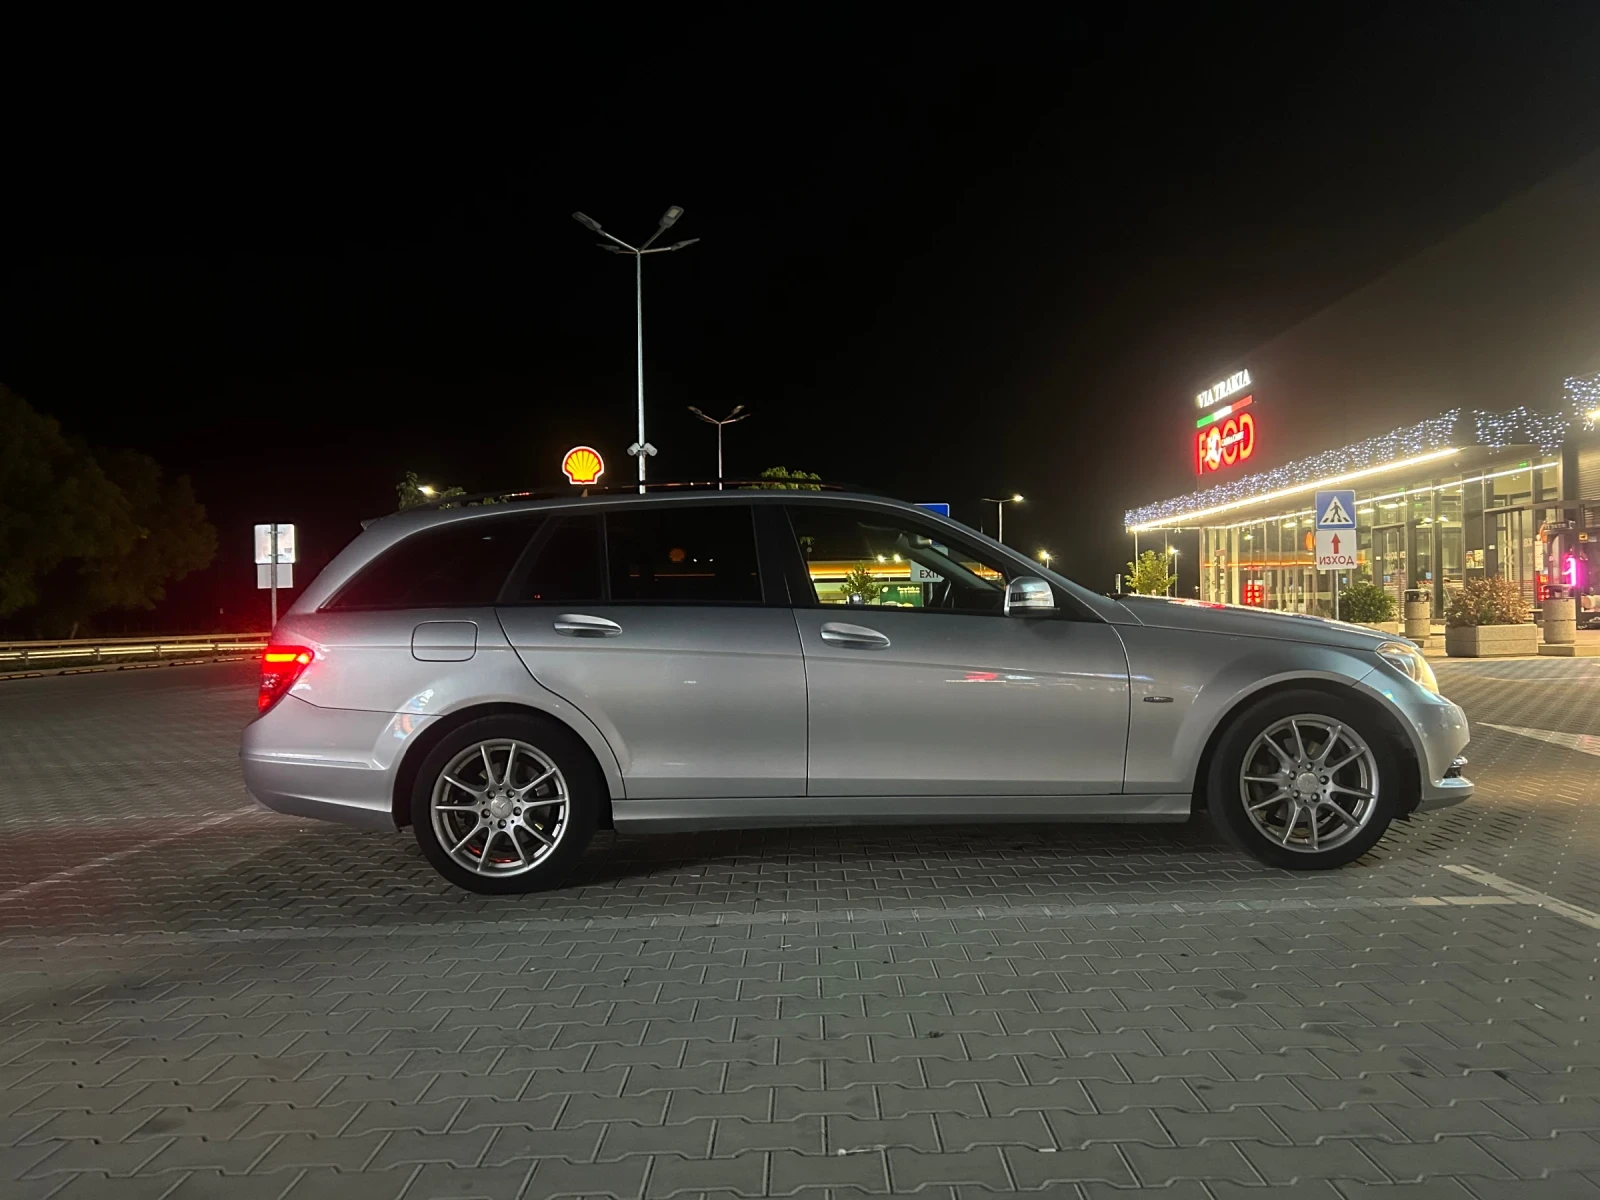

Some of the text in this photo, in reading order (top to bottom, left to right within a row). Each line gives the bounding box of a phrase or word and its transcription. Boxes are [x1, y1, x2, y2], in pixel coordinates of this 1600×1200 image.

[1197, 369, 1251, 408] VIA TRAKIA
[1197, 413, 1254, 475] FOOD
[1319, 555, 1354, 566] ИЗХОД
